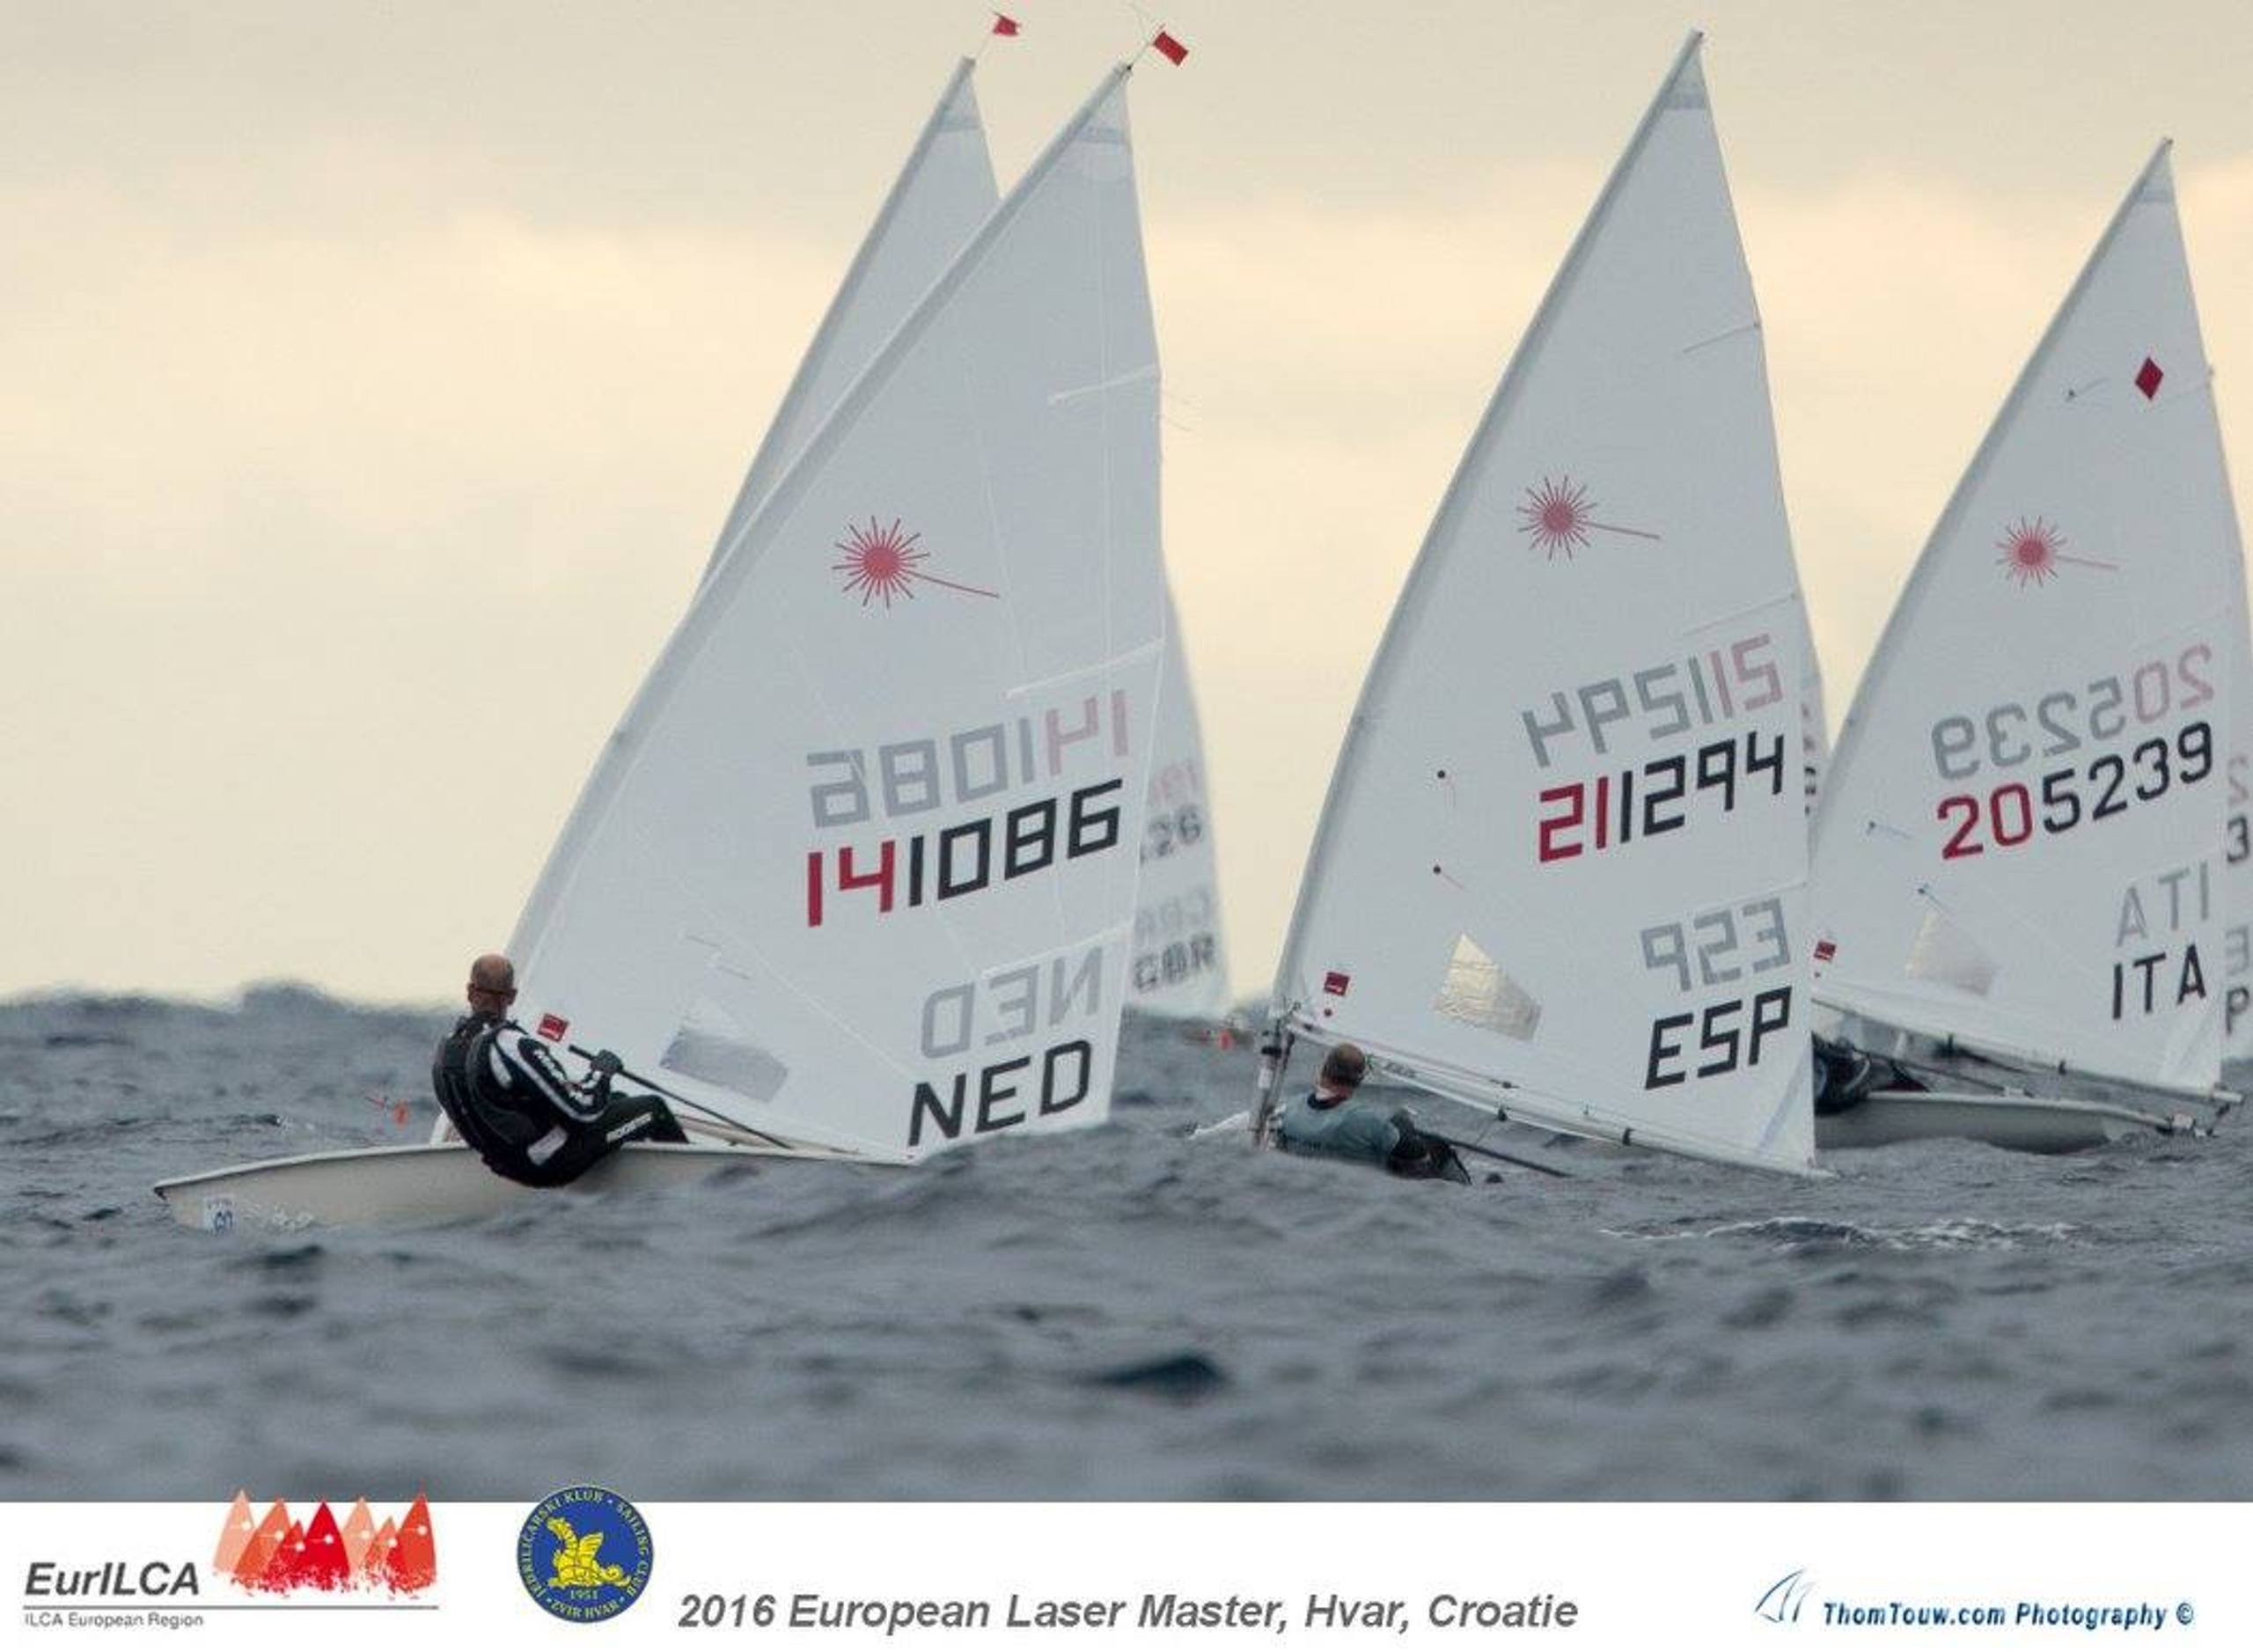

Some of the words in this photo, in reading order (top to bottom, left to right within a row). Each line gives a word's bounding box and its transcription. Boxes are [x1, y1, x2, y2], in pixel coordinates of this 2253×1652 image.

[1539, 731, 1785, 863] 211294
[1936, 722, 2213, 861] 205239
[807, 779, 1123, 928] 141086
[1645, 986, 1792, 1090] ESP
[2112, 943, 2206, 1020] ITA
[908, 1039, 1092, 1147] NED
